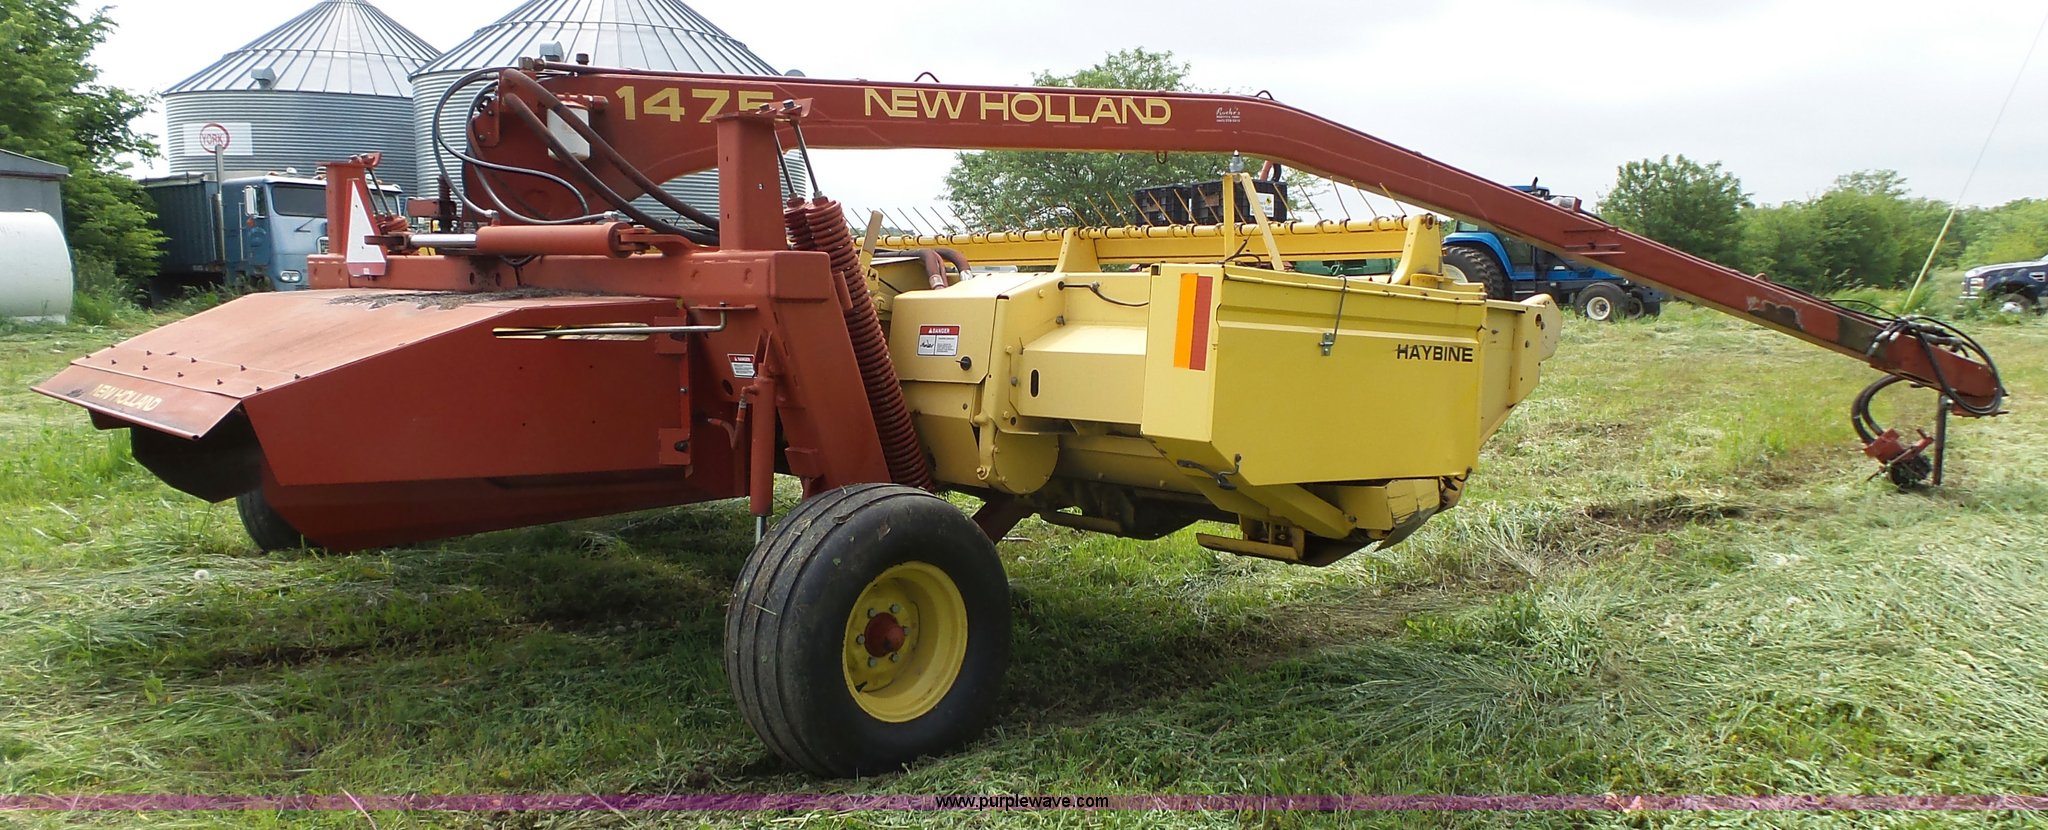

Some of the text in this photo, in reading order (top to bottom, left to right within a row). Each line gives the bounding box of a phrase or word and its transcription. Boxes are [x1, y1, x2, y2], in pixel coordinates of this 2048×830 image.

[864, 88, 1172, 125] NEW HOLLAND
[200, 133, 224, 145] YORK
[1396, 343, 1473, 362] HAYBINE
[91, 384, 162, 412] NEW HOLLAND
